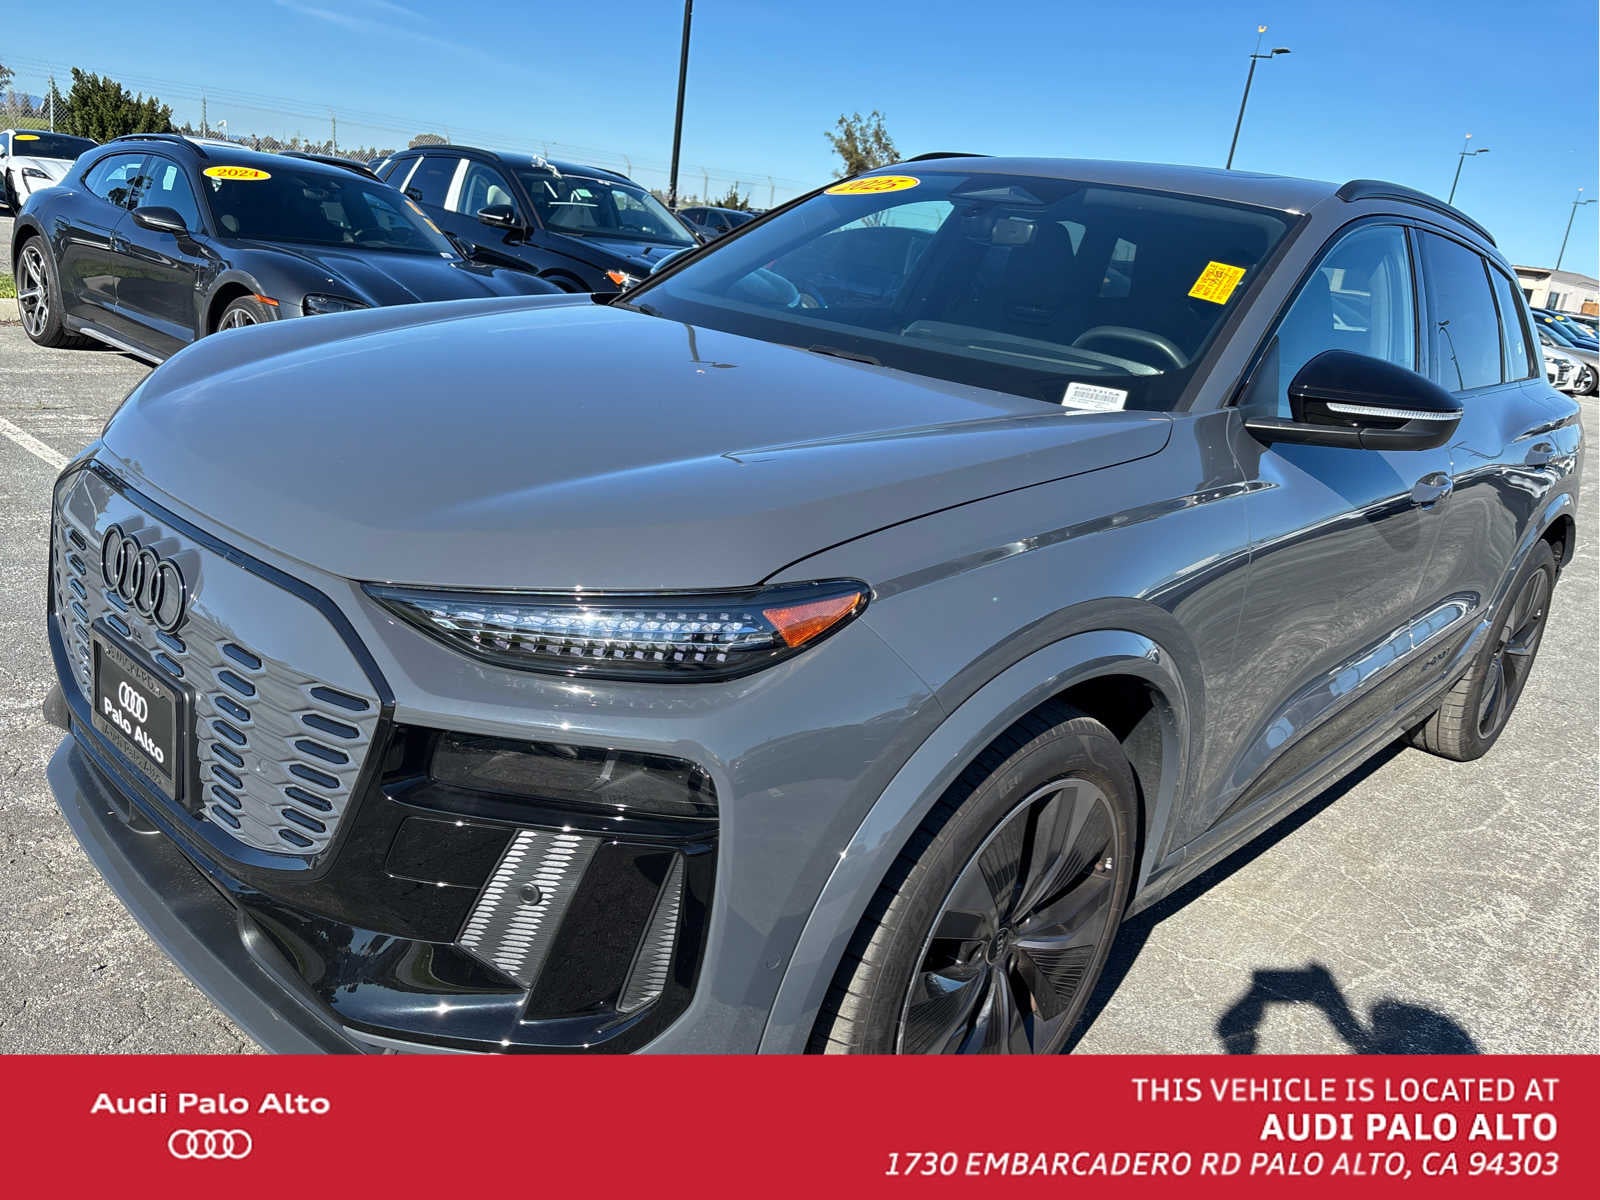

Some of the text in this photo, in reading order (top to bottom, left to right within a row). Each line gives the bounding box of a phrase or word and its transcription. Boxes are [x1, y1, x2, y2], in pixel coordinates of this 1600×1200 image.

[217, 168, 259, 178] 2024
[834, 178, 910, 191] 2025
[104, 697, 165, 764] Palo Alto
